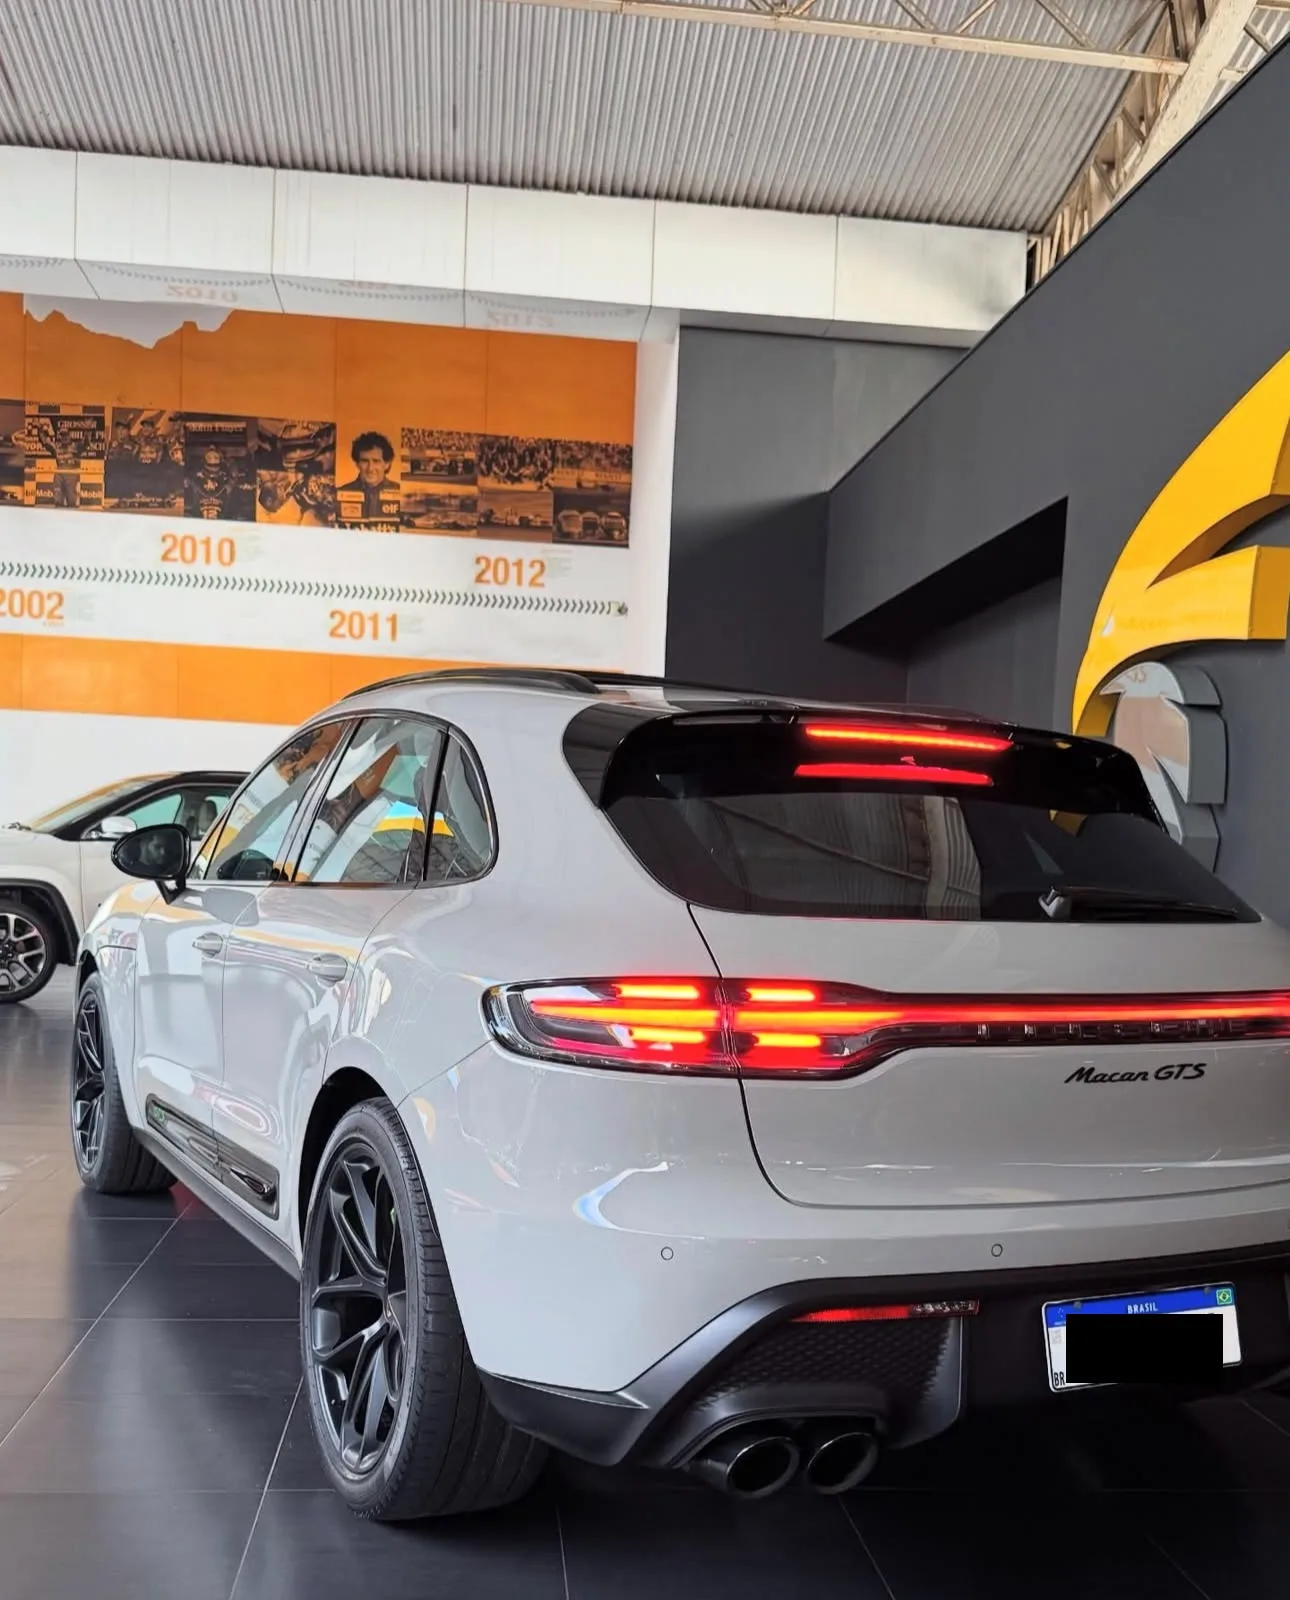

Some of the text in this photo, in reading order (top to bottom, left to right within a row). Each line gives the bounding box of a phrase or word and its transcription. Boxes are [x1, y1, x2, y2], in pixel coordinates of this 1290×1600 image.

[161, 533, 236, 566] 2010
[474, 556, 546, 588] 2012
[329, 609, 398, 642] 2011
[1064, 1063, 1206, 1084] Macan GTS
[1127, 1302, 1158, 1314] BRASIL
[1053, 1371, 1066, 1387] BR
